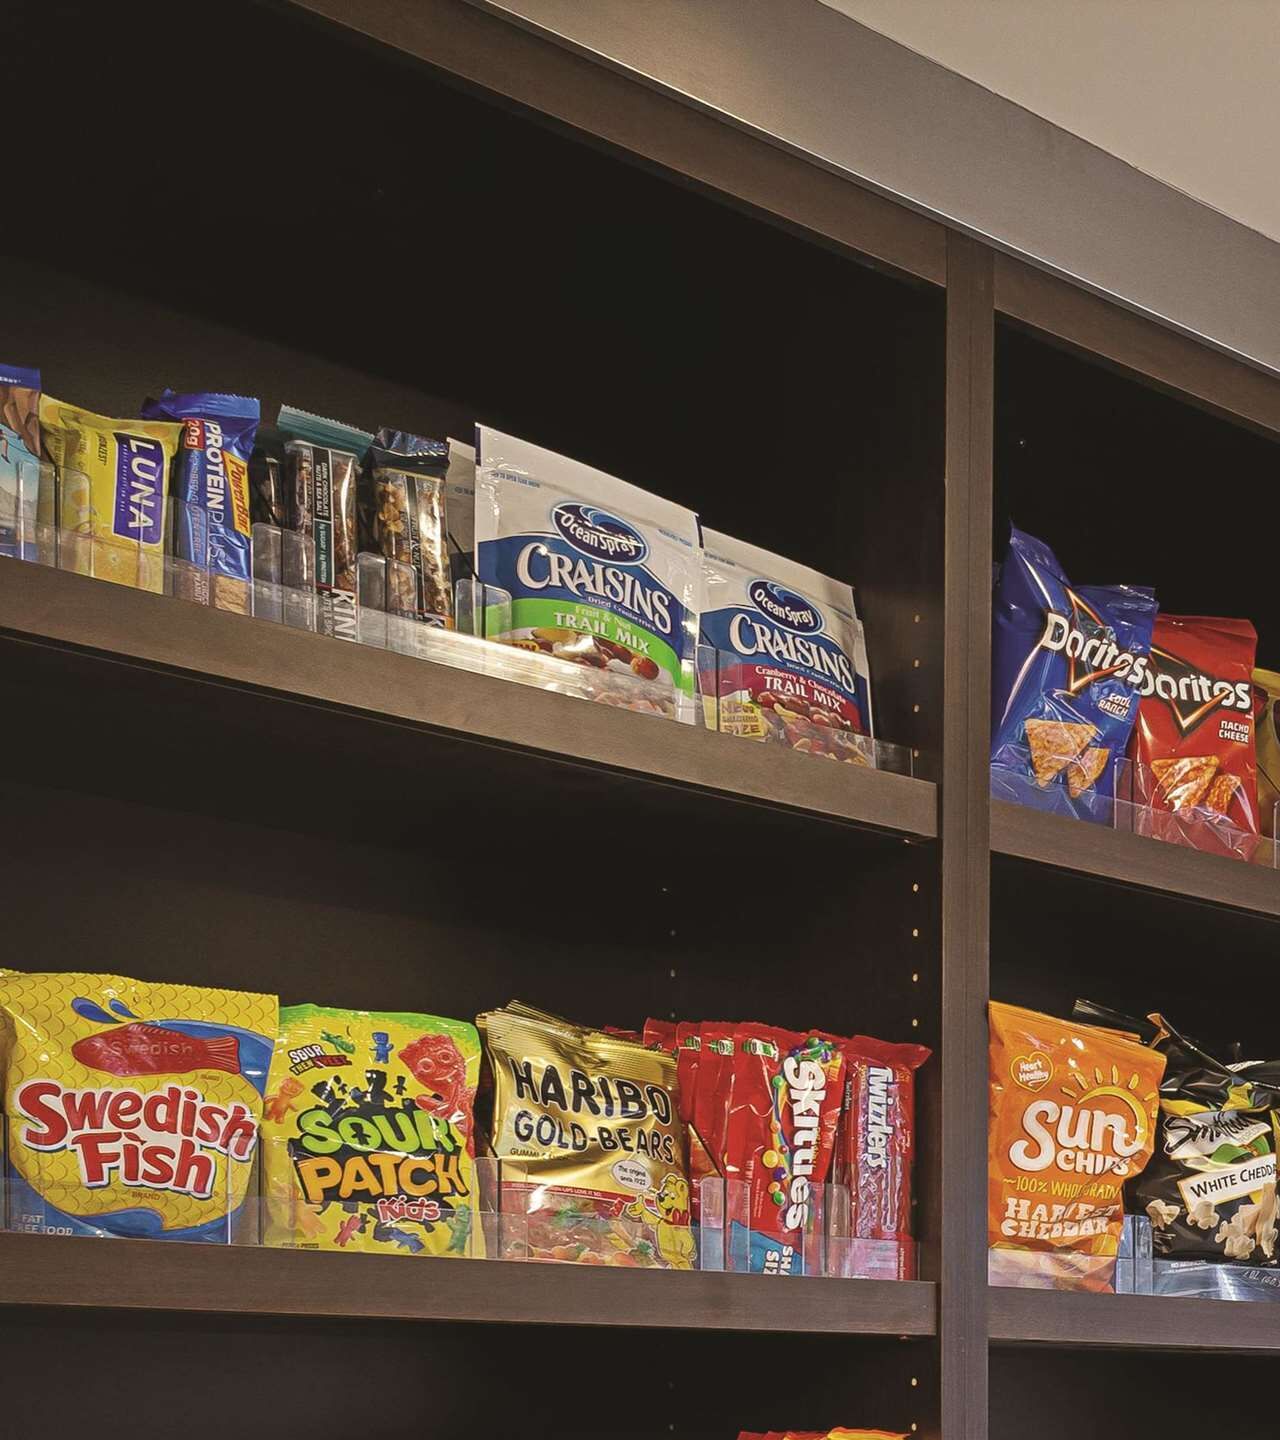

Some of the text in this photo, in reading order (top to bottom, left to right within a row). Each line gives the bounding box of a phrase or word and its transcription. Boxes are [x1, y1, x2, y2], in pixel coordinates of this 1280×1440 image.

[186, 420, 200, 446] 20g
[129, 439, 157, 529] LUNA
[230, 459, 249, 533] PowerBar
[560, 513, 598, 548] Ocean
[600, 533, 636, 556] Spray
[517, 542, 672, 634] CRAISINS
[755, 589, 814, 626] Ocean Spray
[554, 612, 650, 654] TRAIL MIX
[729, 613, 855, 694] CRAISINS
[1042, 612, 1146, 688] Doritos
[755, 665, 845, 705] Cranberry Chocolate
[764, 676, 842, 713] TRAIL MIX
[1097, 698, 1130, 718] RANCH
[1220, 720, 1251, 734] NACHO
[1218, 728, 1250, 744] CHEESE
[289, 1044, 324, 1063] SOUR
[1019, 1059, 1042, 1072] Heart
[509, 1057, 672, 1126] HARIBO
[1019, 1069, 1049, 1081] Healthy
[19, 1081, 259, 1158] Swedish
[300, 1110, 454, 1153] SOUR
[514, 1110, 674, 1164] GOLD-BEARS
[867, 1066, 895, 1169] Twizzlers
[1009, 1100, 1140, 1172] Sun
[71, 1133, 216, 1195] Fish
[299, 1154, 469, 1204] PATCH
[1056, 1149, 1130, 1176] CHIPS
[1190, 1163, 1277, 1199] WHITE CHEDDA
[377, 1196, 440, 1222] Kids
[1001, 1217, 1108, 1239] CHEDDAR
